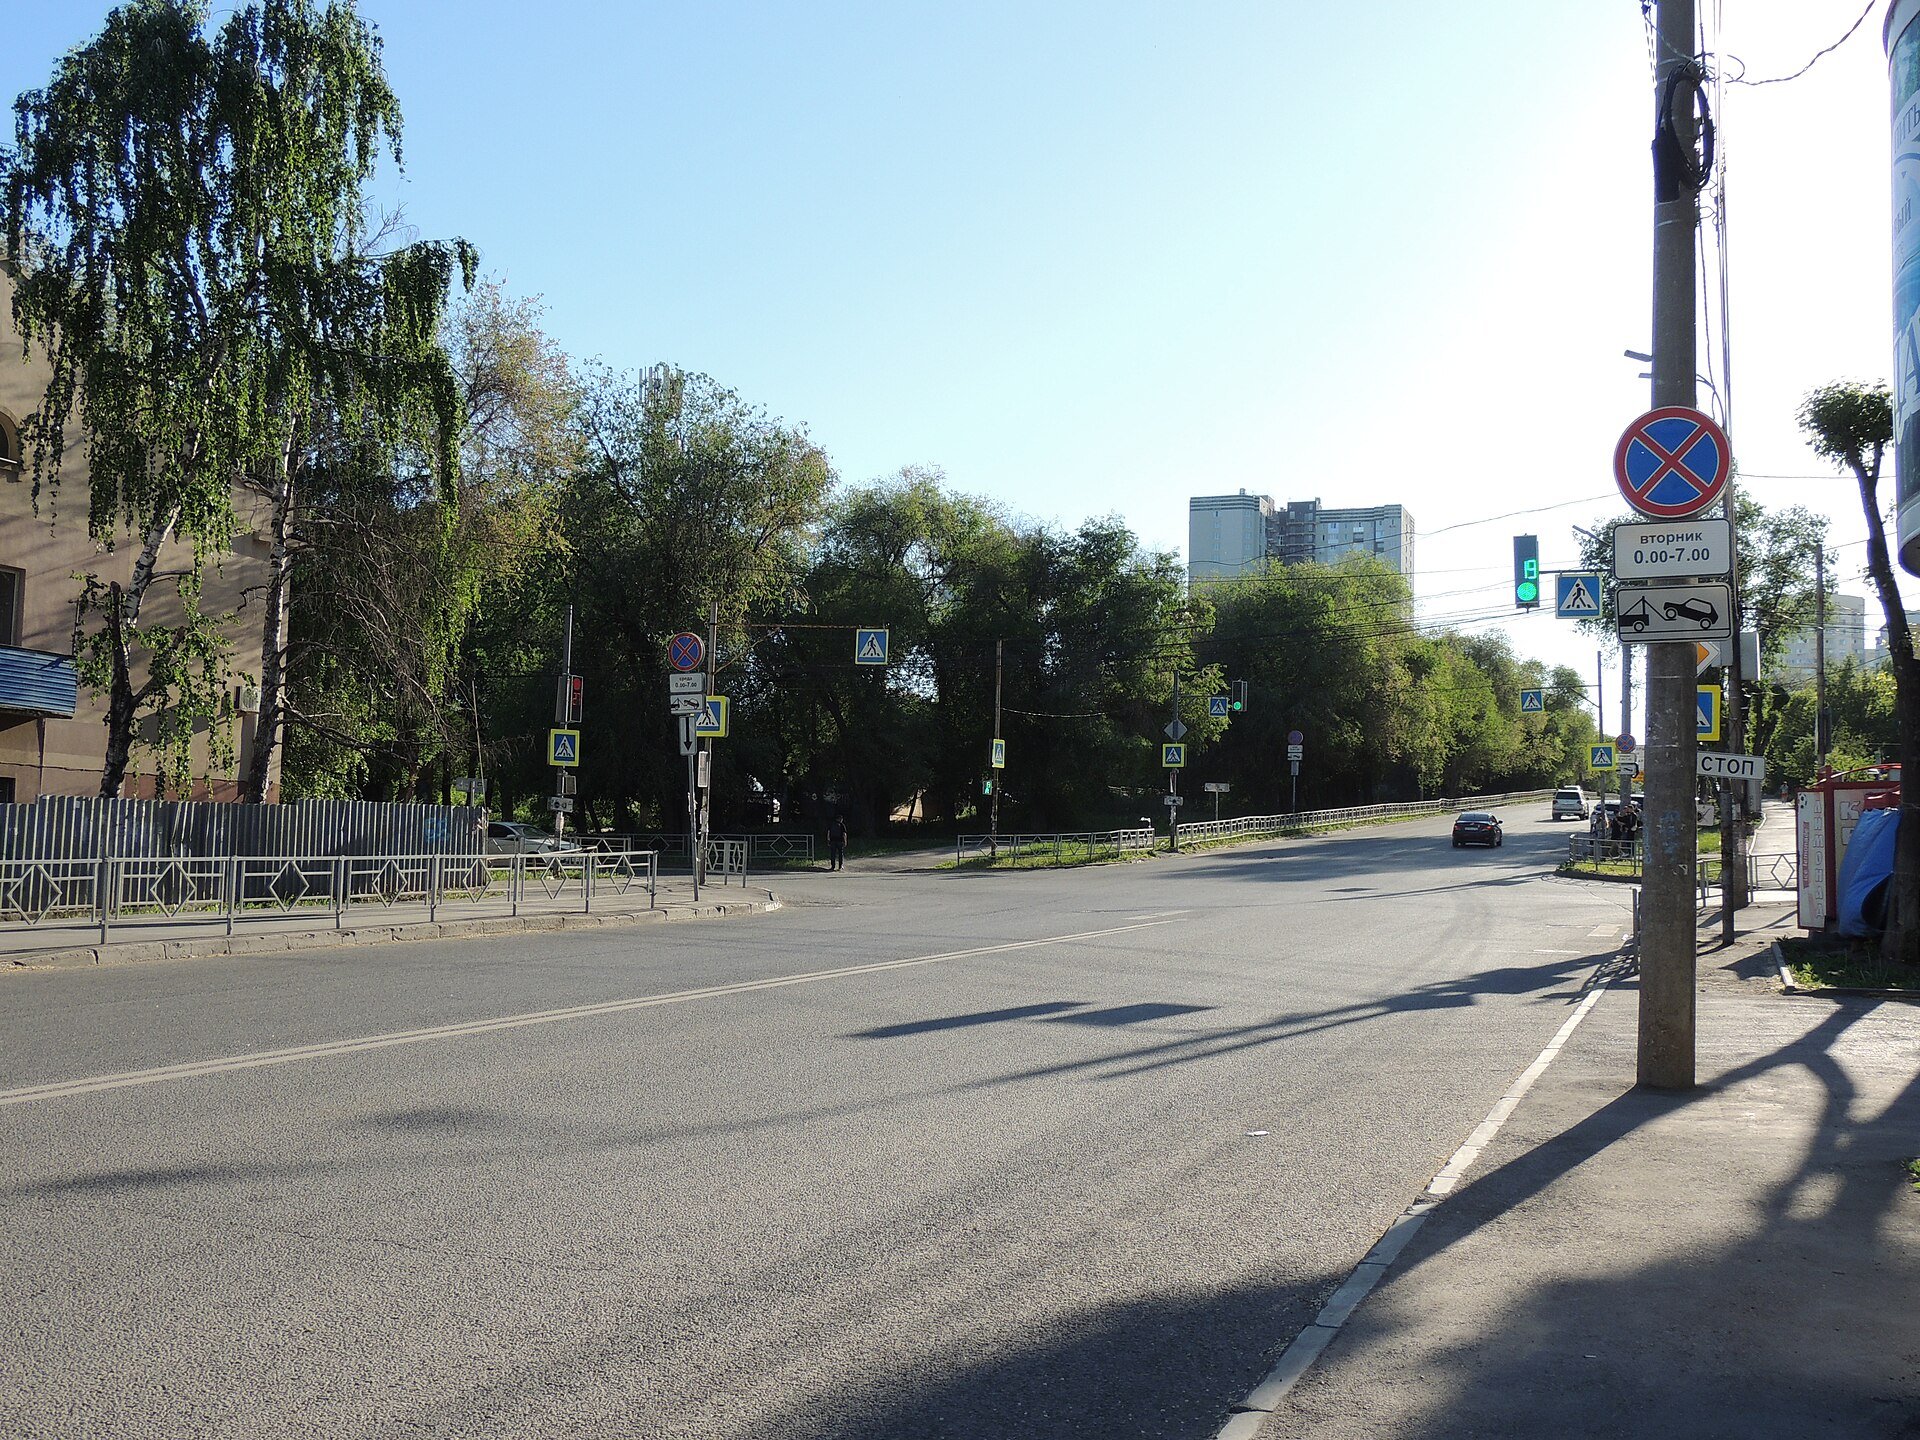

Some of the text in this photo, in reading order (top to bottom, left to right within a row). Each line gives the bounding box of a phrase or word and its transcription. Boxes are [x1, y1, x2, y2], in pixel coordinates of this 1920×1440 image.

[1640, 532, 1703, 545] вторник
[1633, 547, 1710, 564] 0.00-7.00
[1701, 756, 1754, 776] СТОП
